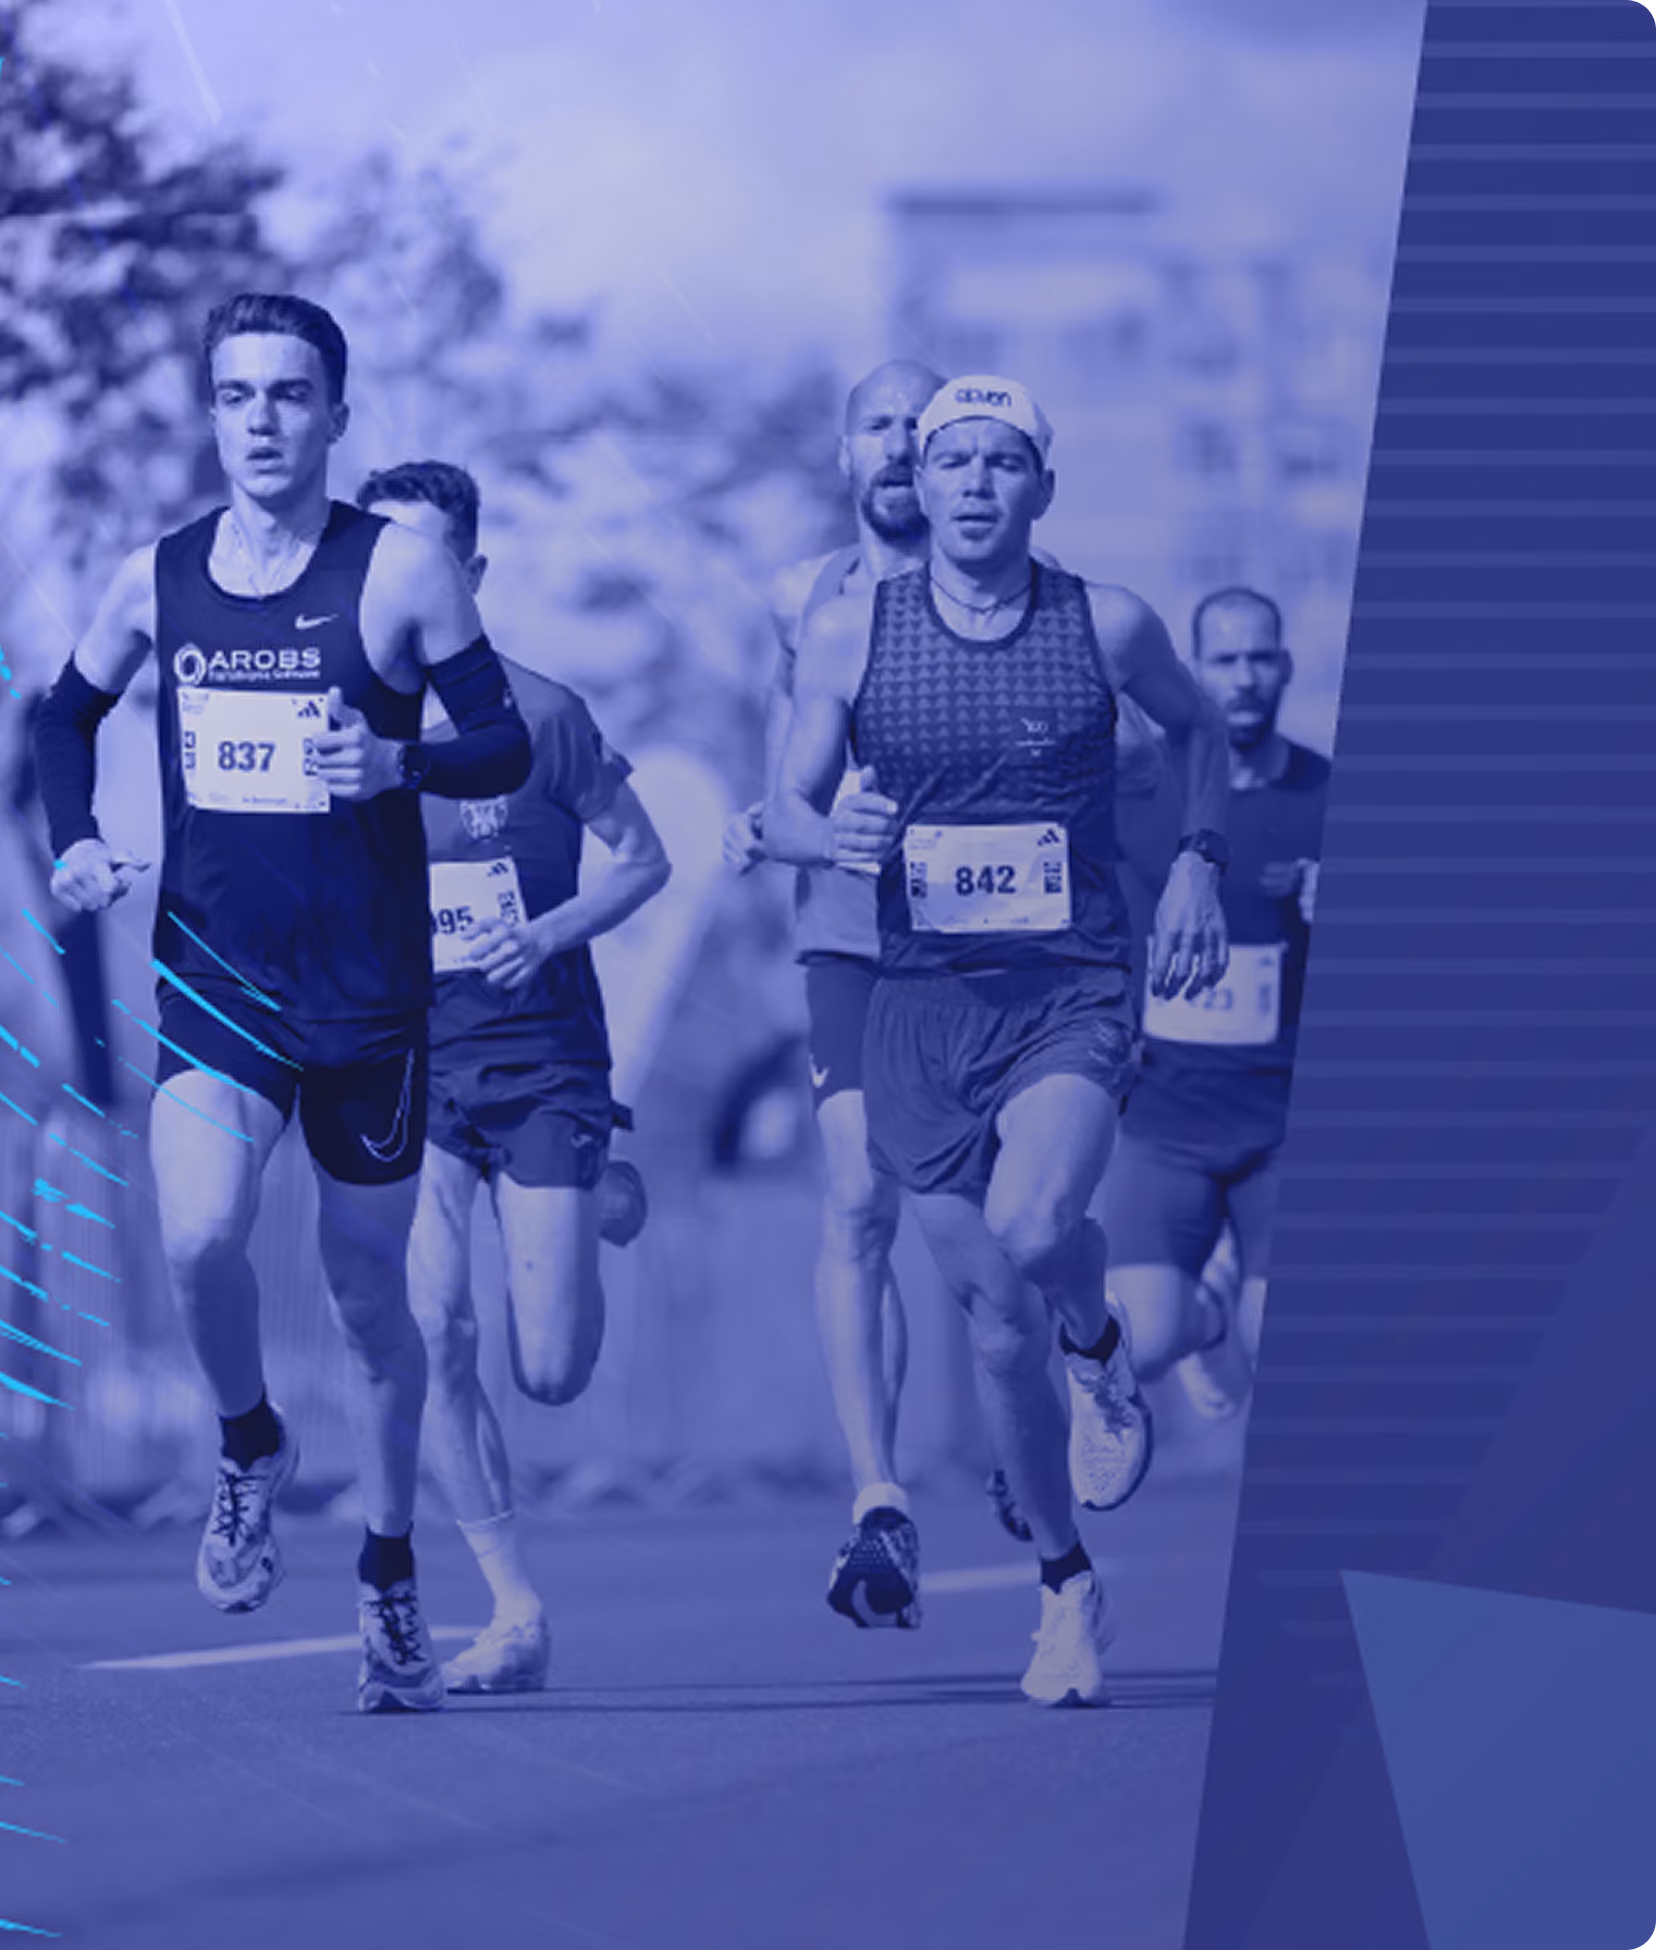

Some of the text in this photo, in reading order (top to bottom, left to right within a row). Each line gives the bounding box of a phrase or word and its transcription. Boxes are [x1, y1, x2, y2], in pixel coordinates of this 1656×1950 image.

[208, 648, 321, 670] AROBS
[218, 741, 275, 772] 837
[955, 865, 1016, 896] 842
